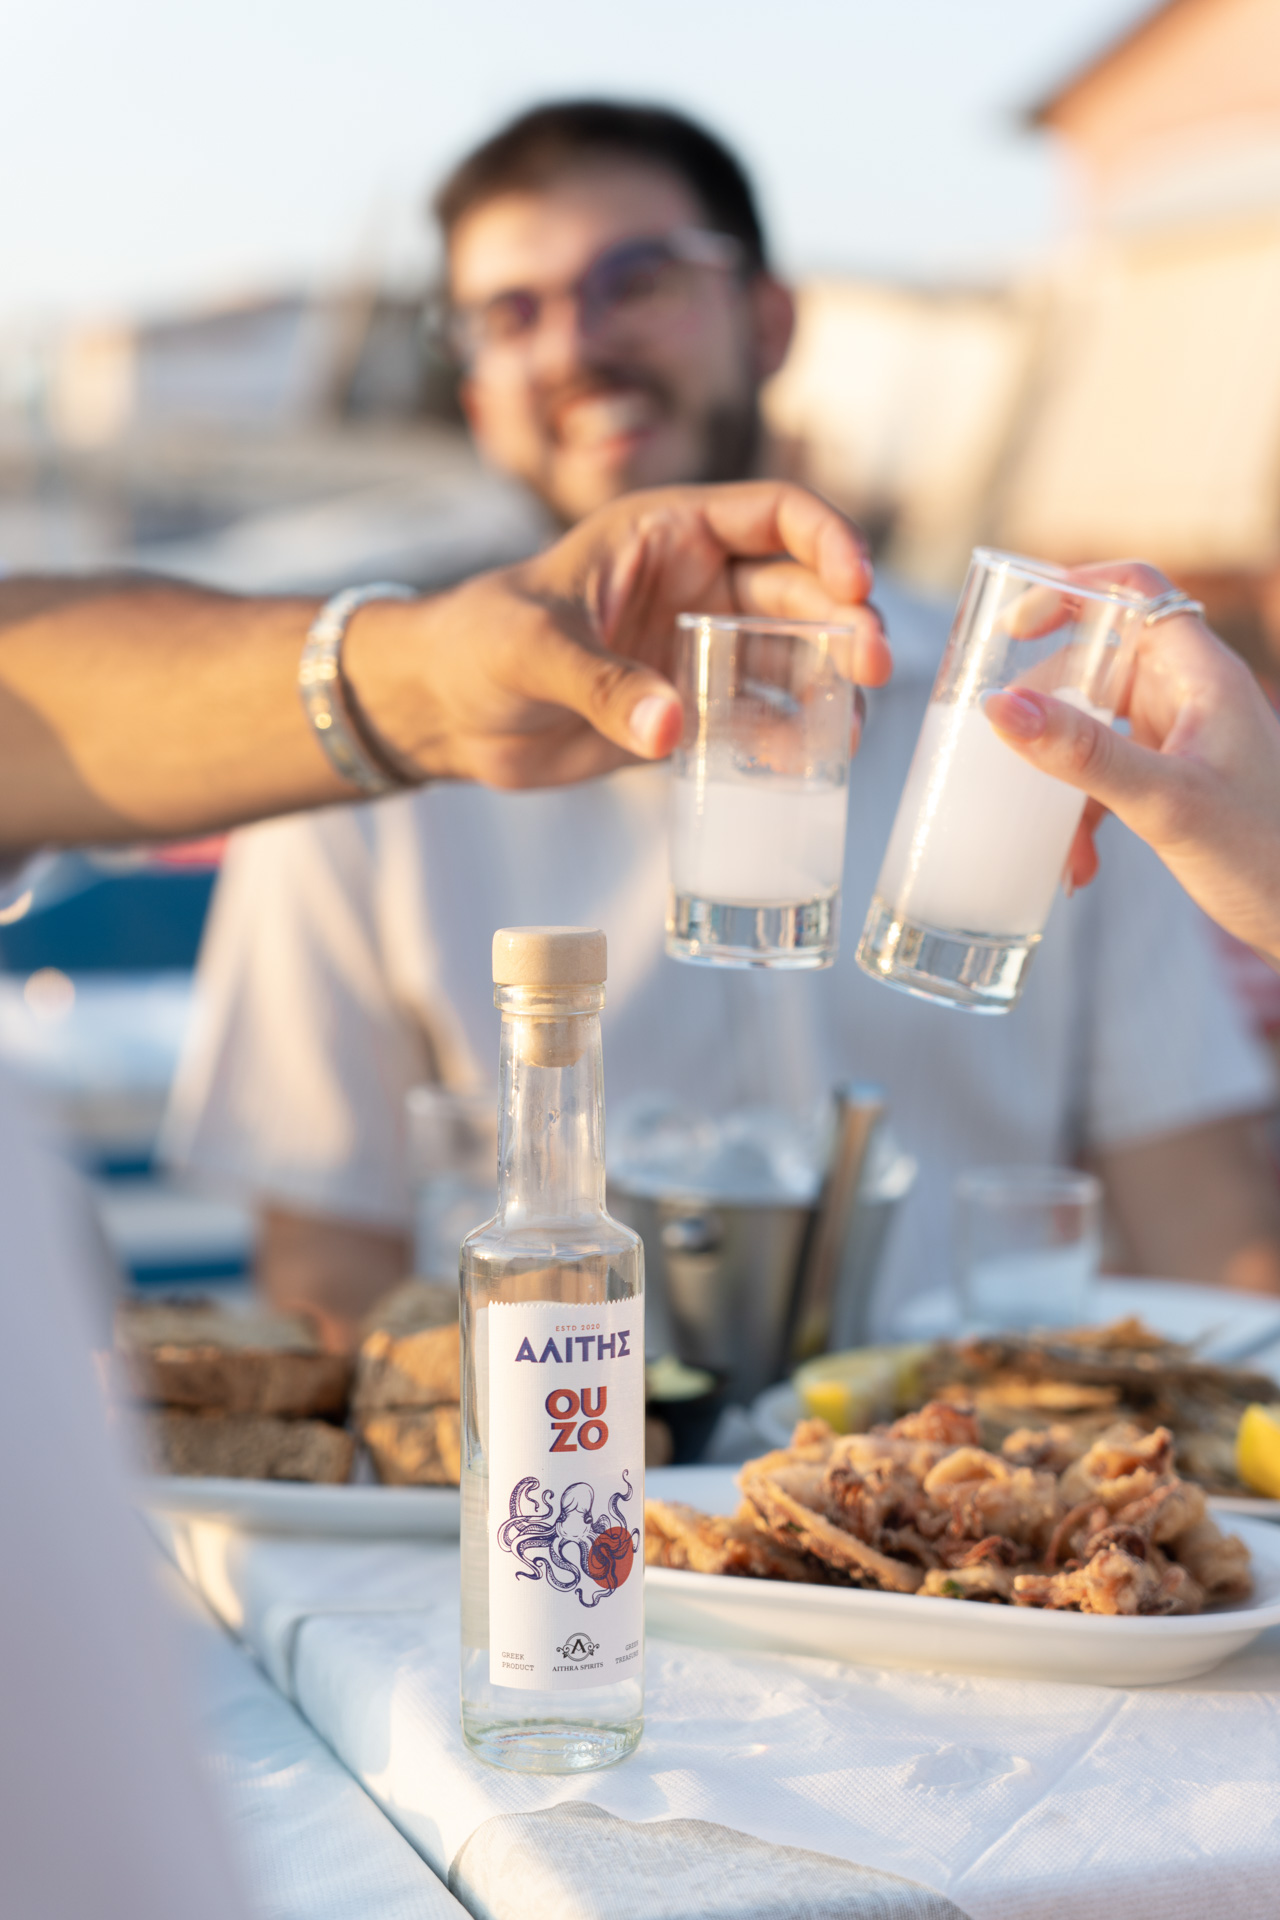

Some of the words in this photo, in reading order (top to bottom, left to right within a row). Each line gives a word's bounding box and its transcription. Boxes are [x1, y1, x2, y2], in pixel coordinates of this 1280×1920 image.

[580, 1323, 601, 1331] 2020
[514, 1330, 631, 1363] ΑΛΙΤΗΣ
[545, 1386, 607, 1420] OU
[549, 1419, 609, 1452] ZO
[501, 1651, 525, 1660] GREEK
[501, 1661, 535, 1671] PRODUCT
[580, 1662, 604, 1671] SPIRITS
